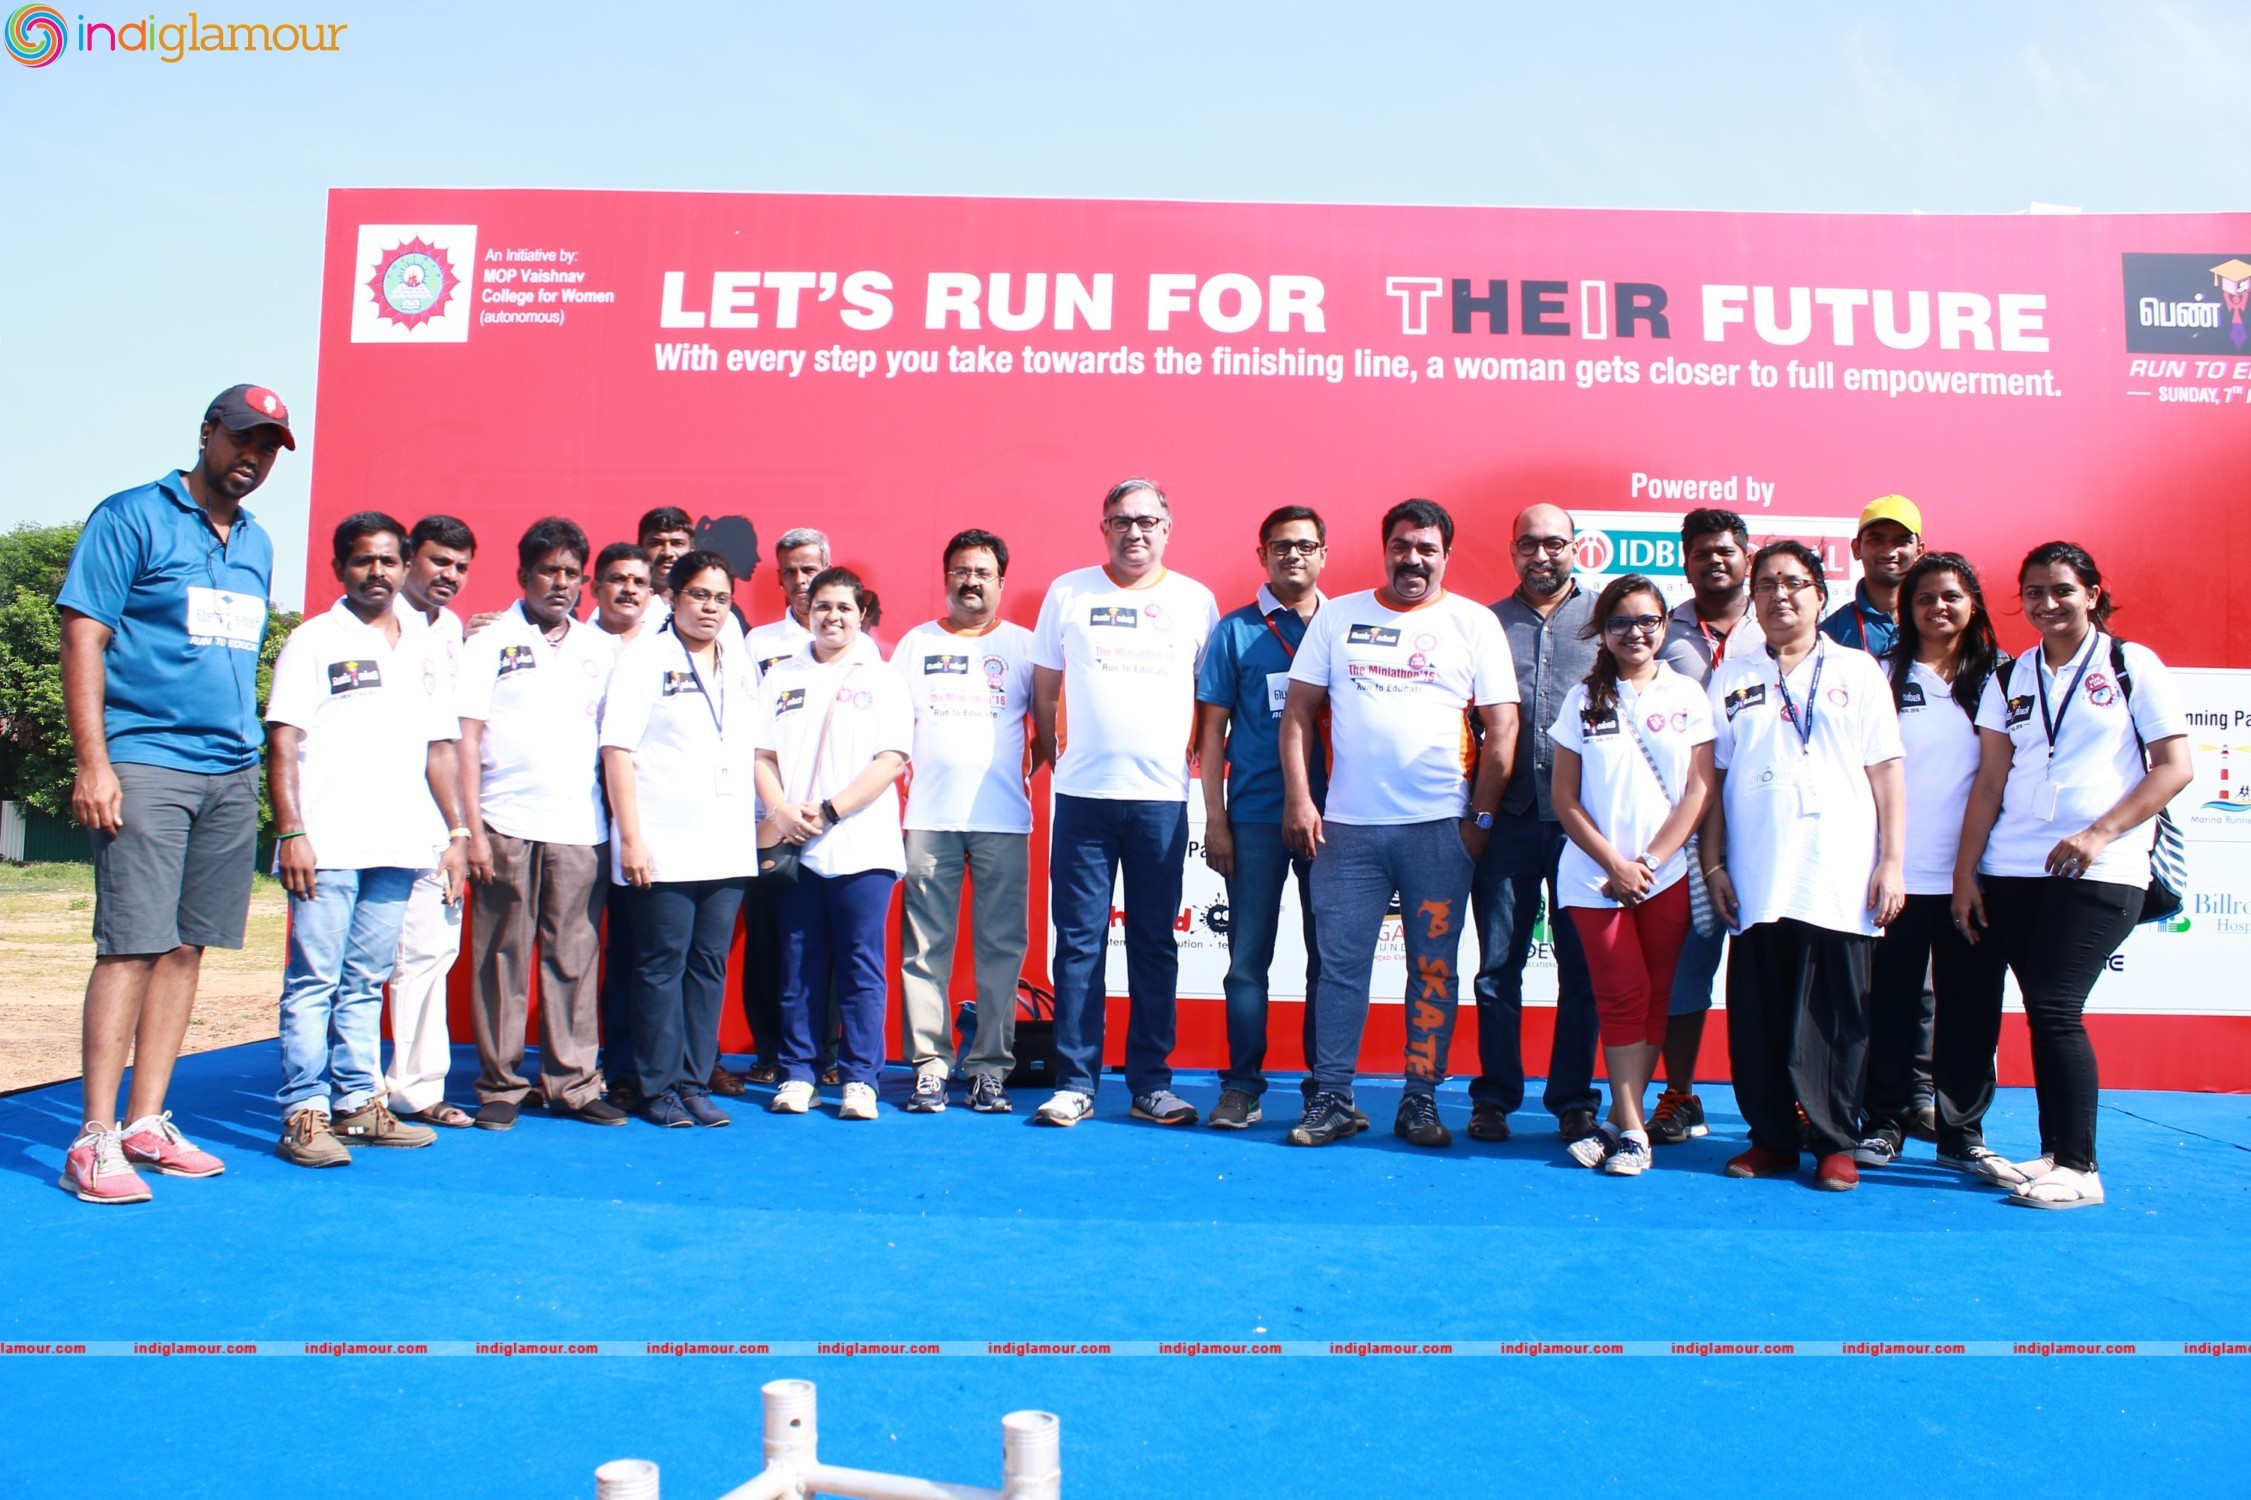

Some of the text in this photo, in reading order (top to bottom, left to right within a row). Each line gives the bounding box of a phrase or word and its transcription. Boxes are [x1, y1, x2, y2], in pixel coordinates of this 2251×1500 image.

[485, 248, 579, 265] An Initiative by:
[483, 268, 586, 283] MOP Vaishnav
[481, 288, 616, 307] College for Women
[479, 309, 565, 326] (autonomous)
[660, 270, 2050, 353] LET'S RUN FOR THEIR FUTURE
[2139, 293, 2222, 328] பெண்
[655, 343, 2062, 398] With every step you take towards the finishing line, a woman gets closer to full empowerment.
[2129, 360, 2186, 378] RUN
[2195, 361, 2226, 378] TO
[2159, 386, 2219, 405] SUNDAY,
[1631, 472, 1775, 508] Powered by
[1348, 664, 1366, 676] The
[2194, 893, 2251, 914] Billro
[1406, 954, 1450, 1080] SKATE
